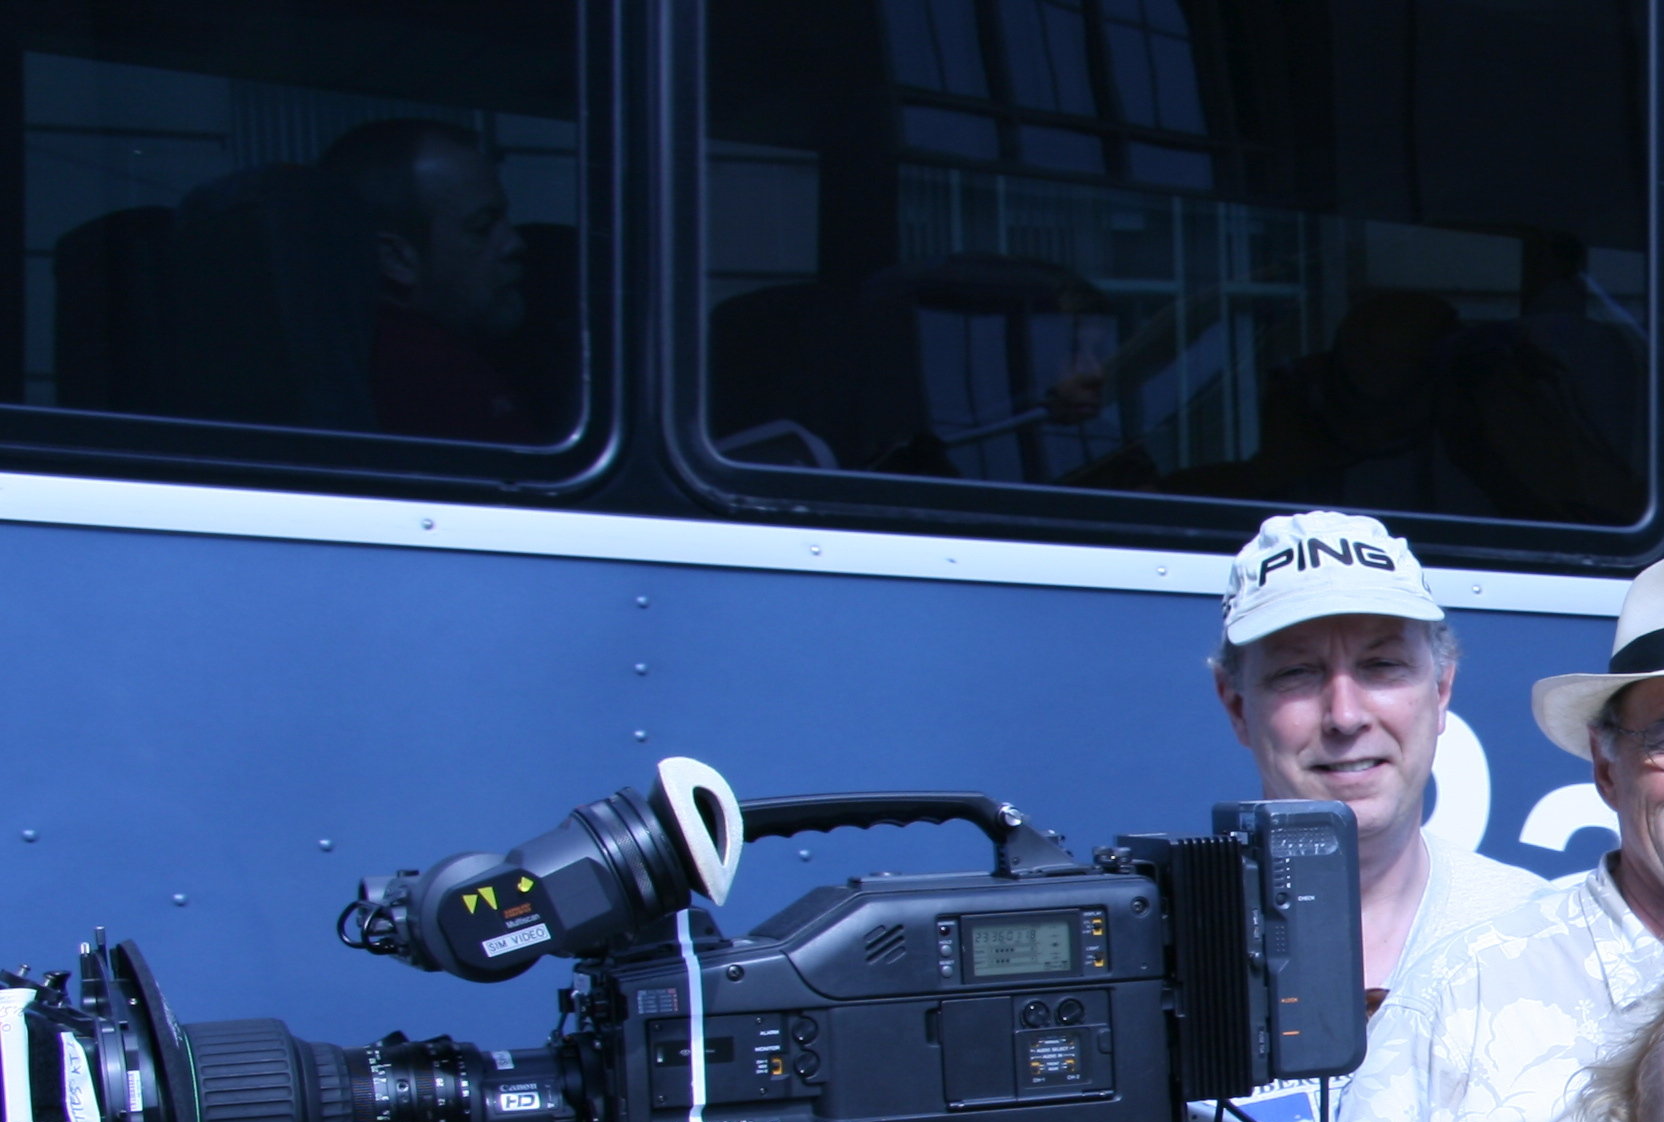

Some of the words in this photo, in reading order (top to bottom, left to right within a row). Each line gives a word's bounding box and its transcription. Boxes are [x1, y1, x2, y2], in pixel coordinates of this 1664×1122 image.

[1259, 538, 1395, 587] PING
[487, 940, 507, 952] SIM
[511, 928, 544, 944] VIDEO
[500, 1082, 537, 1092] Canon
[505, 1094, 536, 1109] HD
